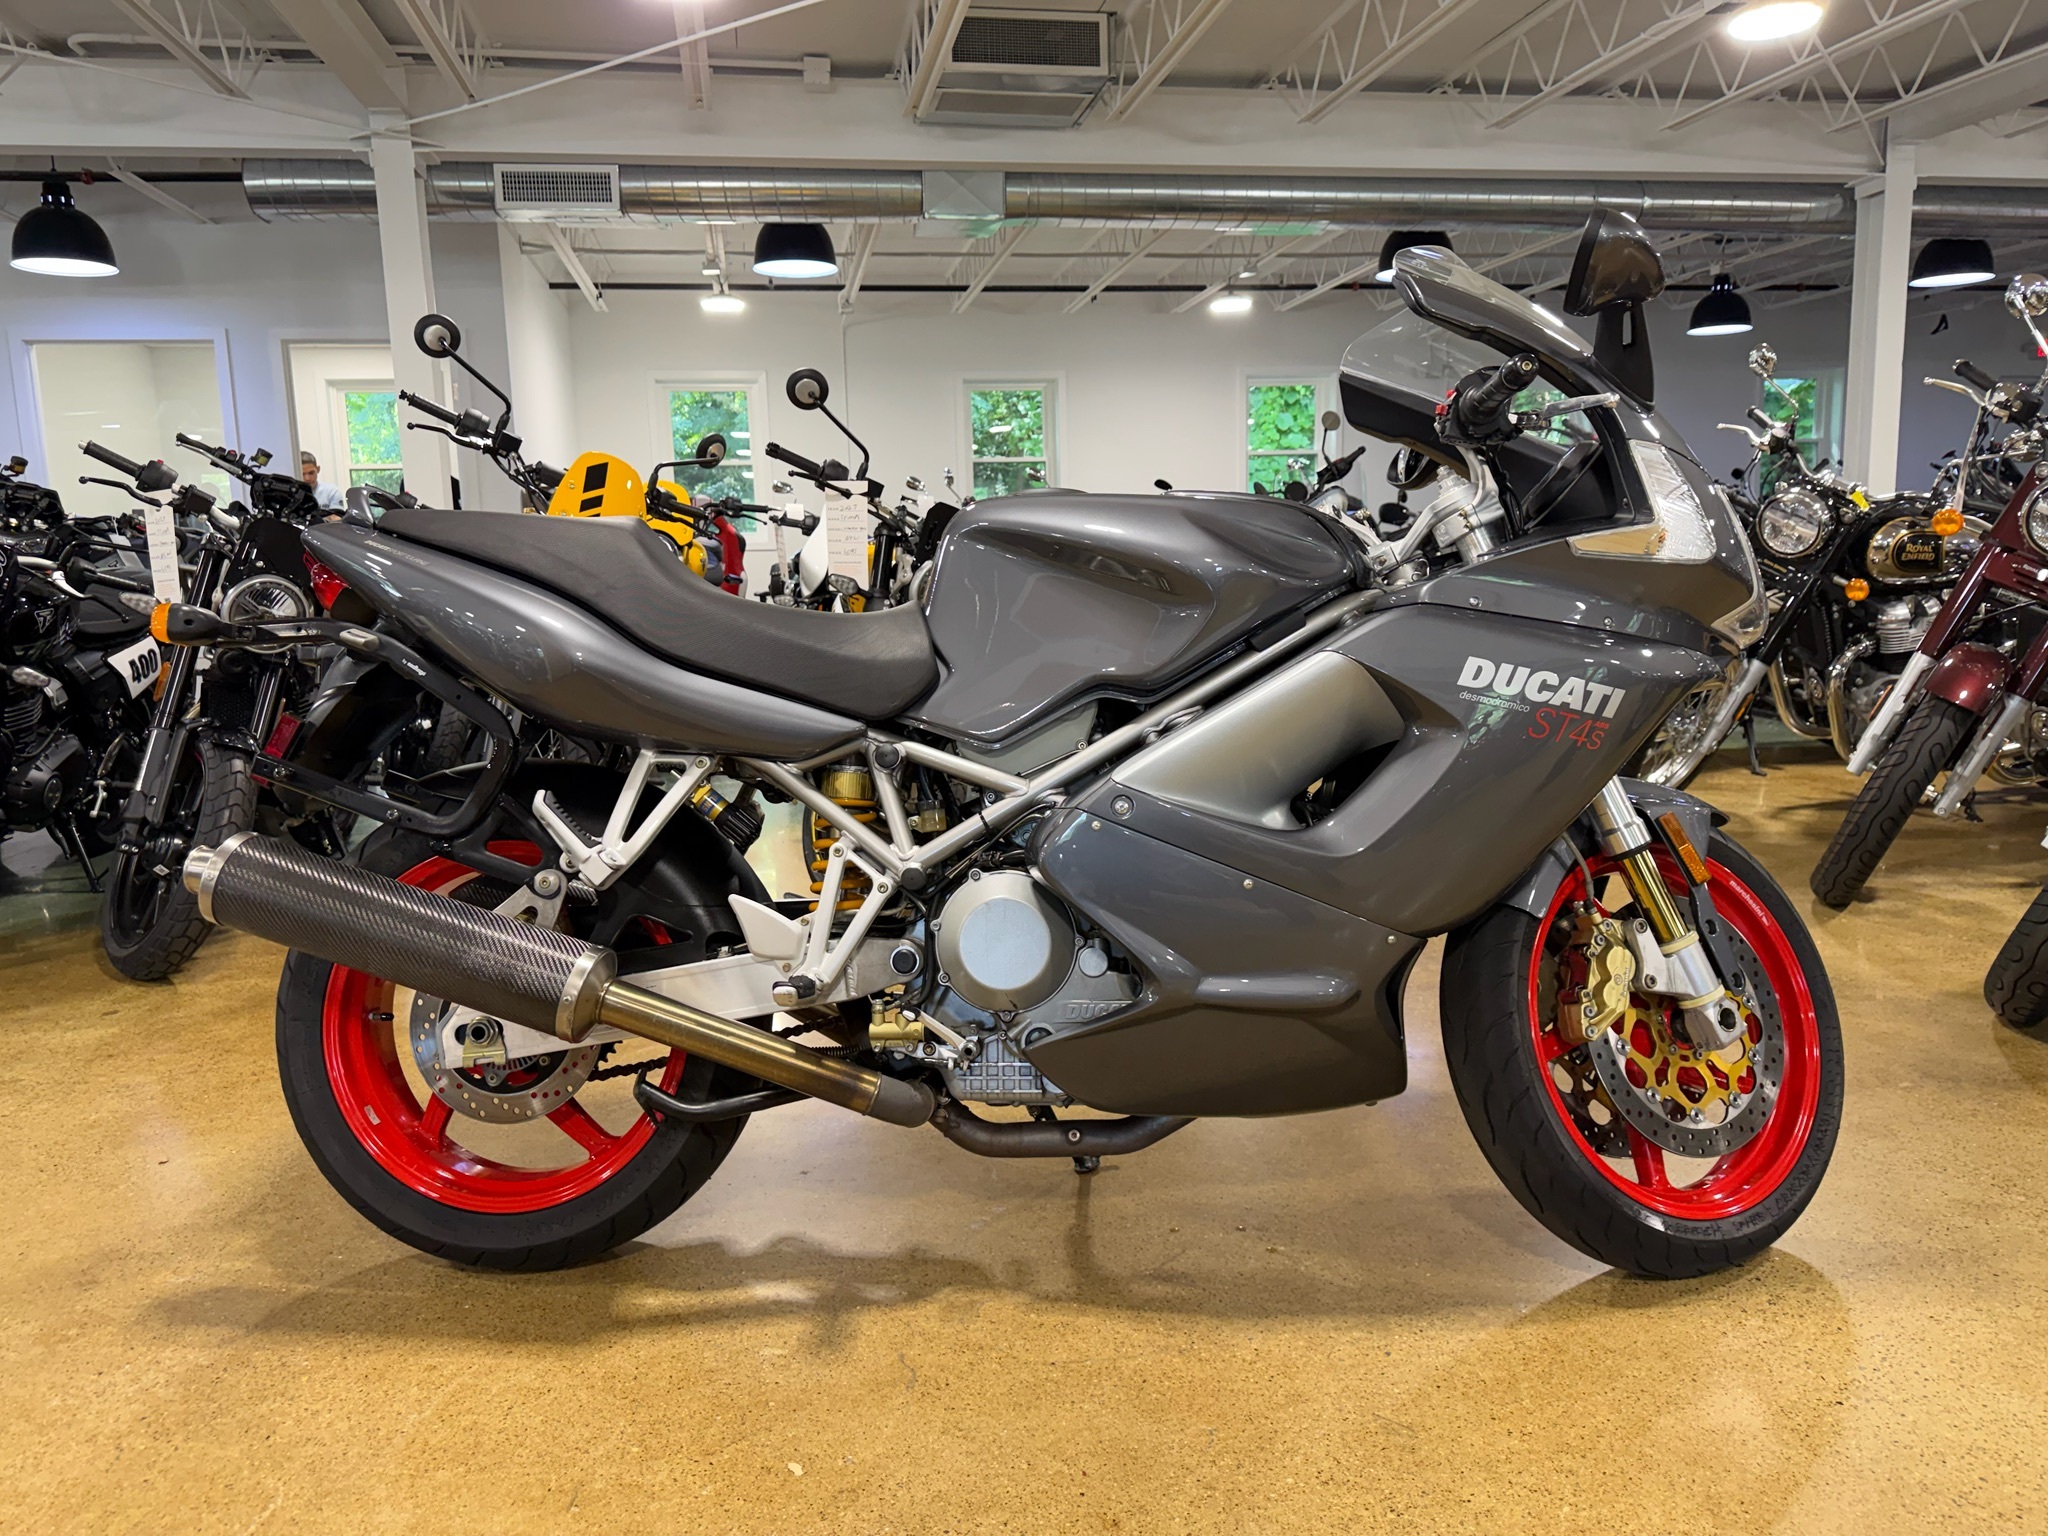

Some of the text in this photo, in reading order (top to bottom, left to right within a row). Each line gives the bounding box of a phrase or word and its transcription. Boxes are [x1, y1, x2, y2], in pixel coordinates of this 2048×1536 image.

[1901, 552, 1936, 561] ENFIELD
[1906, 543, 1934, 552] ROYAL
[127, 647, 159, 684] 400
[1456, 655, 1626, 719] DUCATI
[1459, 690, 1531, 713] desmodromico
[1729, 880, 1765, 917] marchesini
